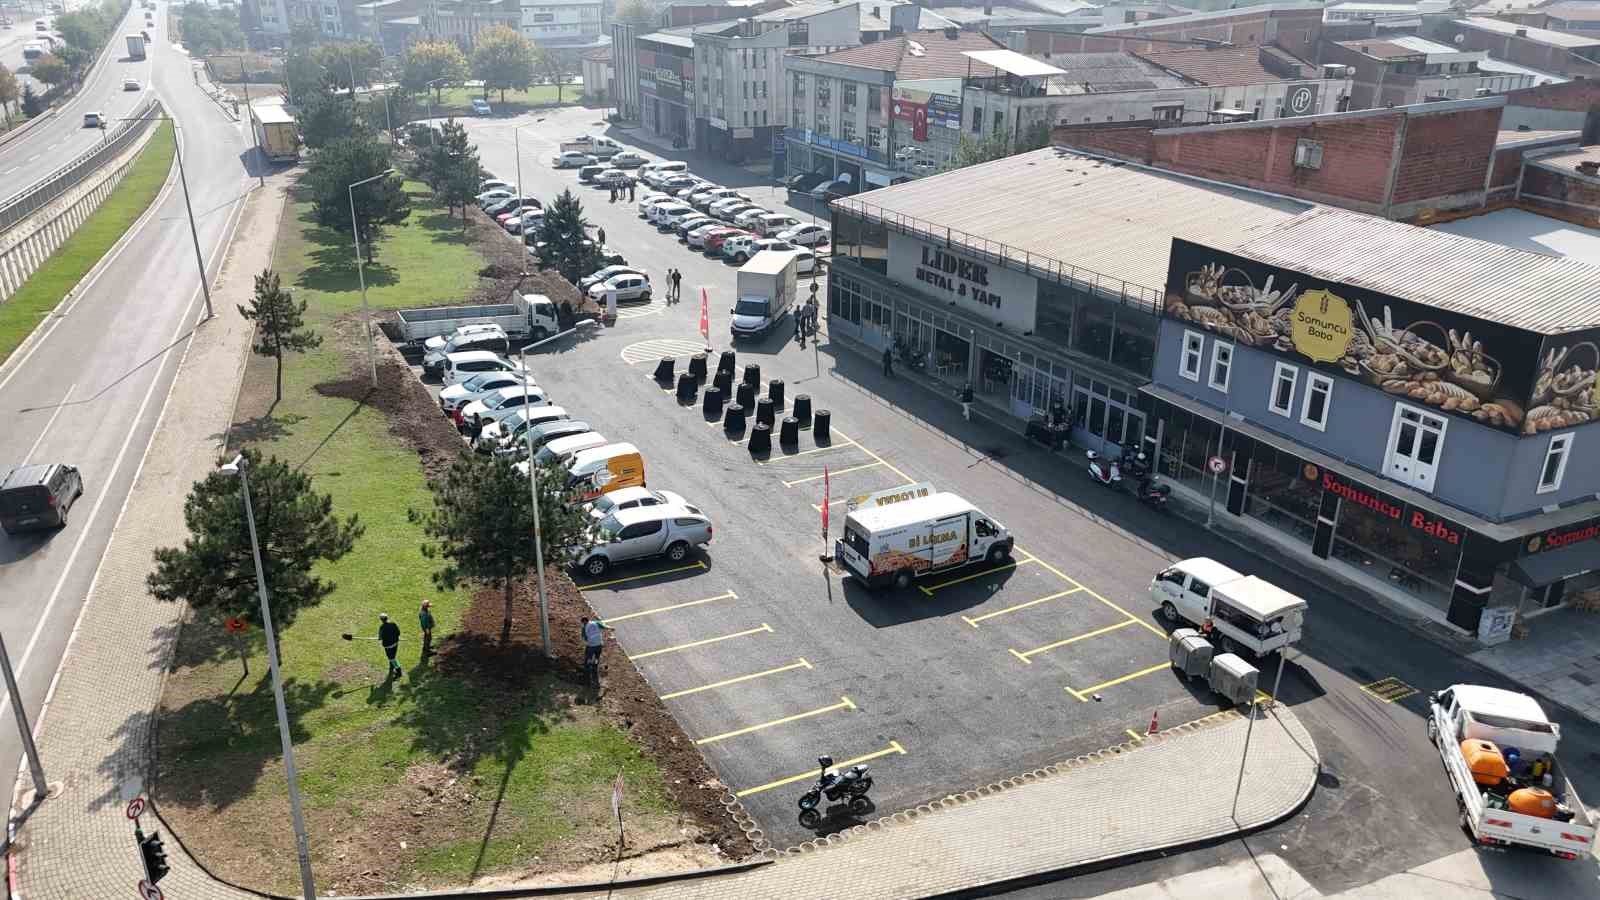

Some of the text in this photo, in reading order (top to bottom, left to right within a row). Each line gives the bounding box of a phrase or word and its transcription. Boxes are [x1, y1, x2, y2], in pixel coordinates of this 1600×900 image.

[916, 267, 955, 292] METAL
[971, 287, 1002, 309] YAPI
[1297, 311, 1347, 335] Somuncu
[1308, 326, 1333, 341] Baba
[1321, 472, 1459, 545] Somuncu Baba
